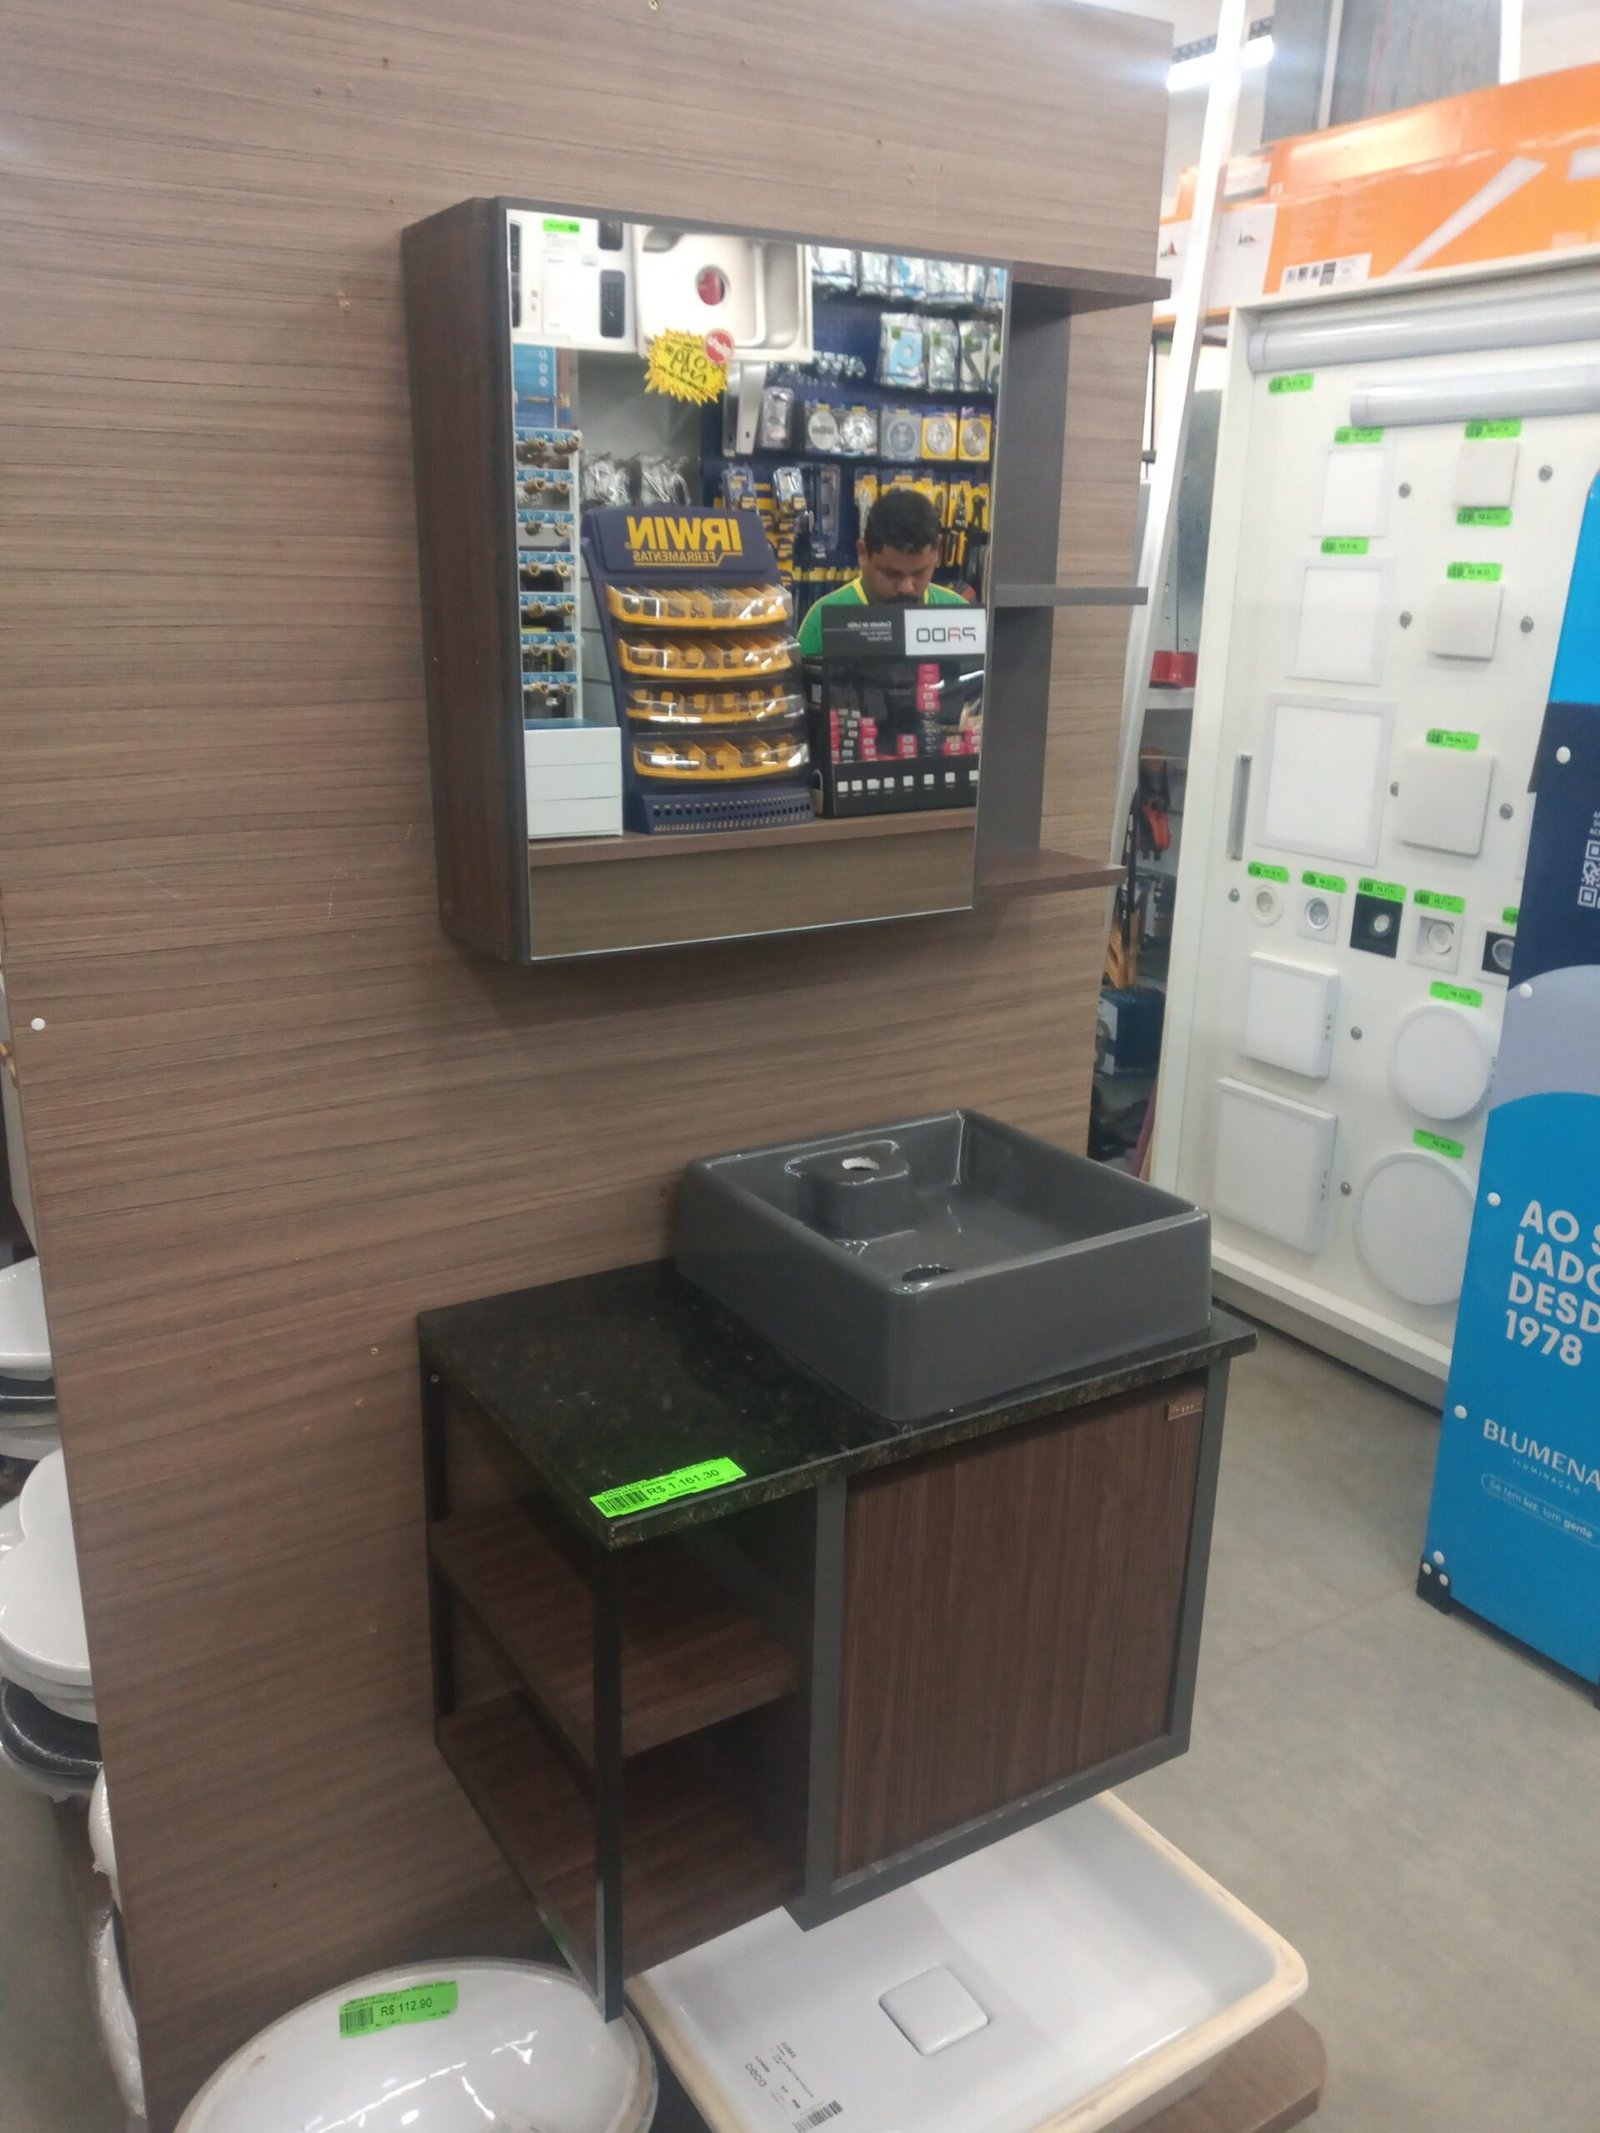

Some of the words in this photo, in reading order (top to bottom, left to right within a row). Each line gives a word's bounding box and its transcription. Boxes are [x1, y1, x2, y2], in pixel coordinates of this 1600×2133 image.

[1519, 1199, 1580, 1243] AO
[1505, 1309, 1583, 1367] 1978
[1483, 1418, 1600, 1493] BLUMENA
[646, 1486, 667, 1497] R$
[380, 2004, 396, 2017] R$
